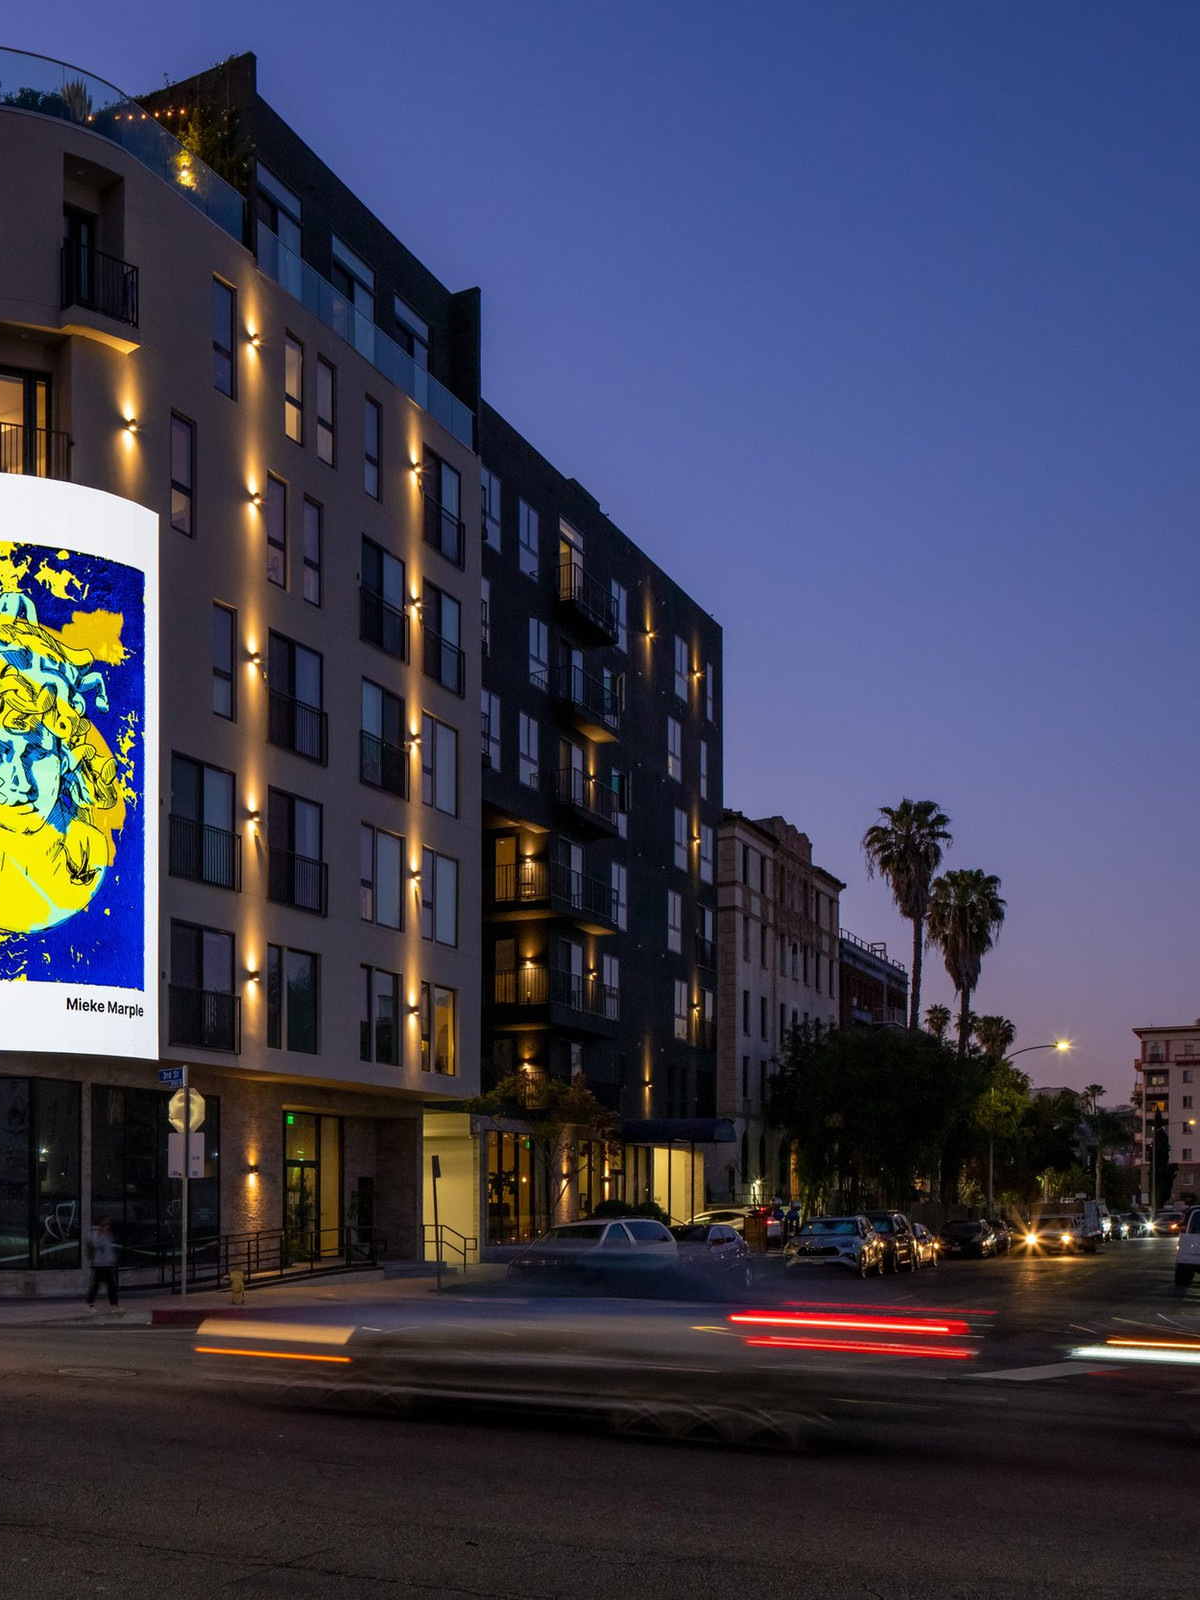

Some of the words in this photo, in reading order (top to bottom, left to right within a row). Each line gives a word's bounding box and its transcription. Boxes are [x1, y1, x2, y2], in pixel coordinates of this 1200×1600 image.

[66, 997, 105, 1013] Mieke
[107, 1001, 144, 1018] Marple
[162, 1071, 172, 1080] 3rd
[173, 1070, 180, 1078] St
